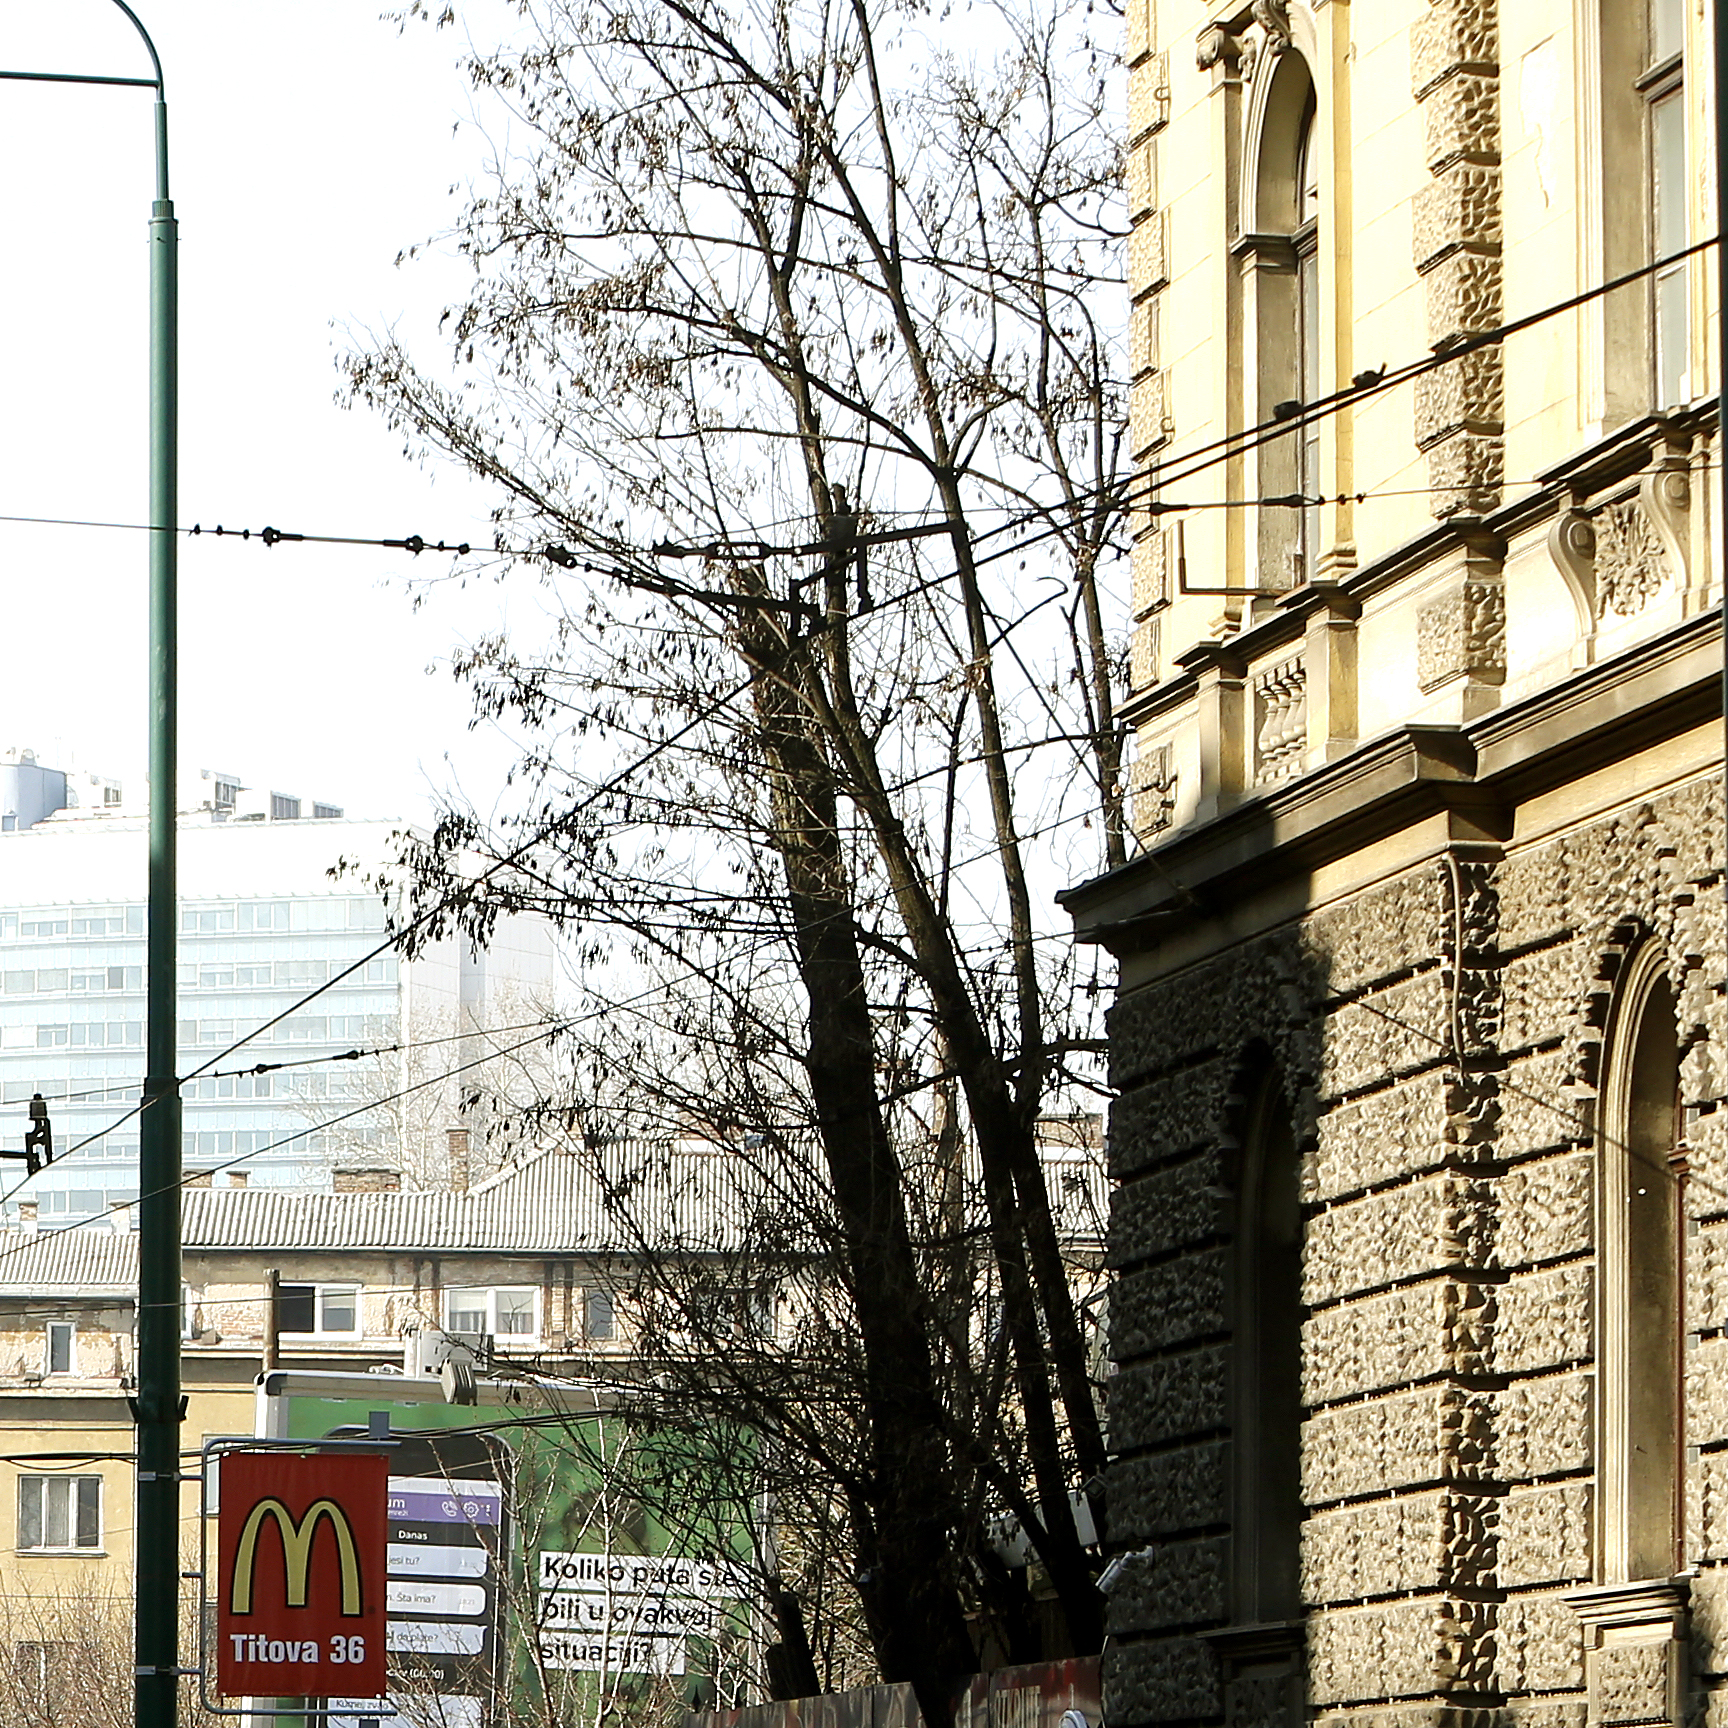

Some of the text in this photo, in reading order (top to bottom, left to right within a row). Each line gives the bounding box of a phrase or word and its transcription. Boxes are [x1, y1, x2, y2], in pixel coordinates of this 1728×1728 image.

[398, 1530, 428, 1541] Danas
[544, 1557, 625, 1582] Koliko
[632, 1563, 690, 1587] puta
[229, 1633, 365, 1664] Titova 36
